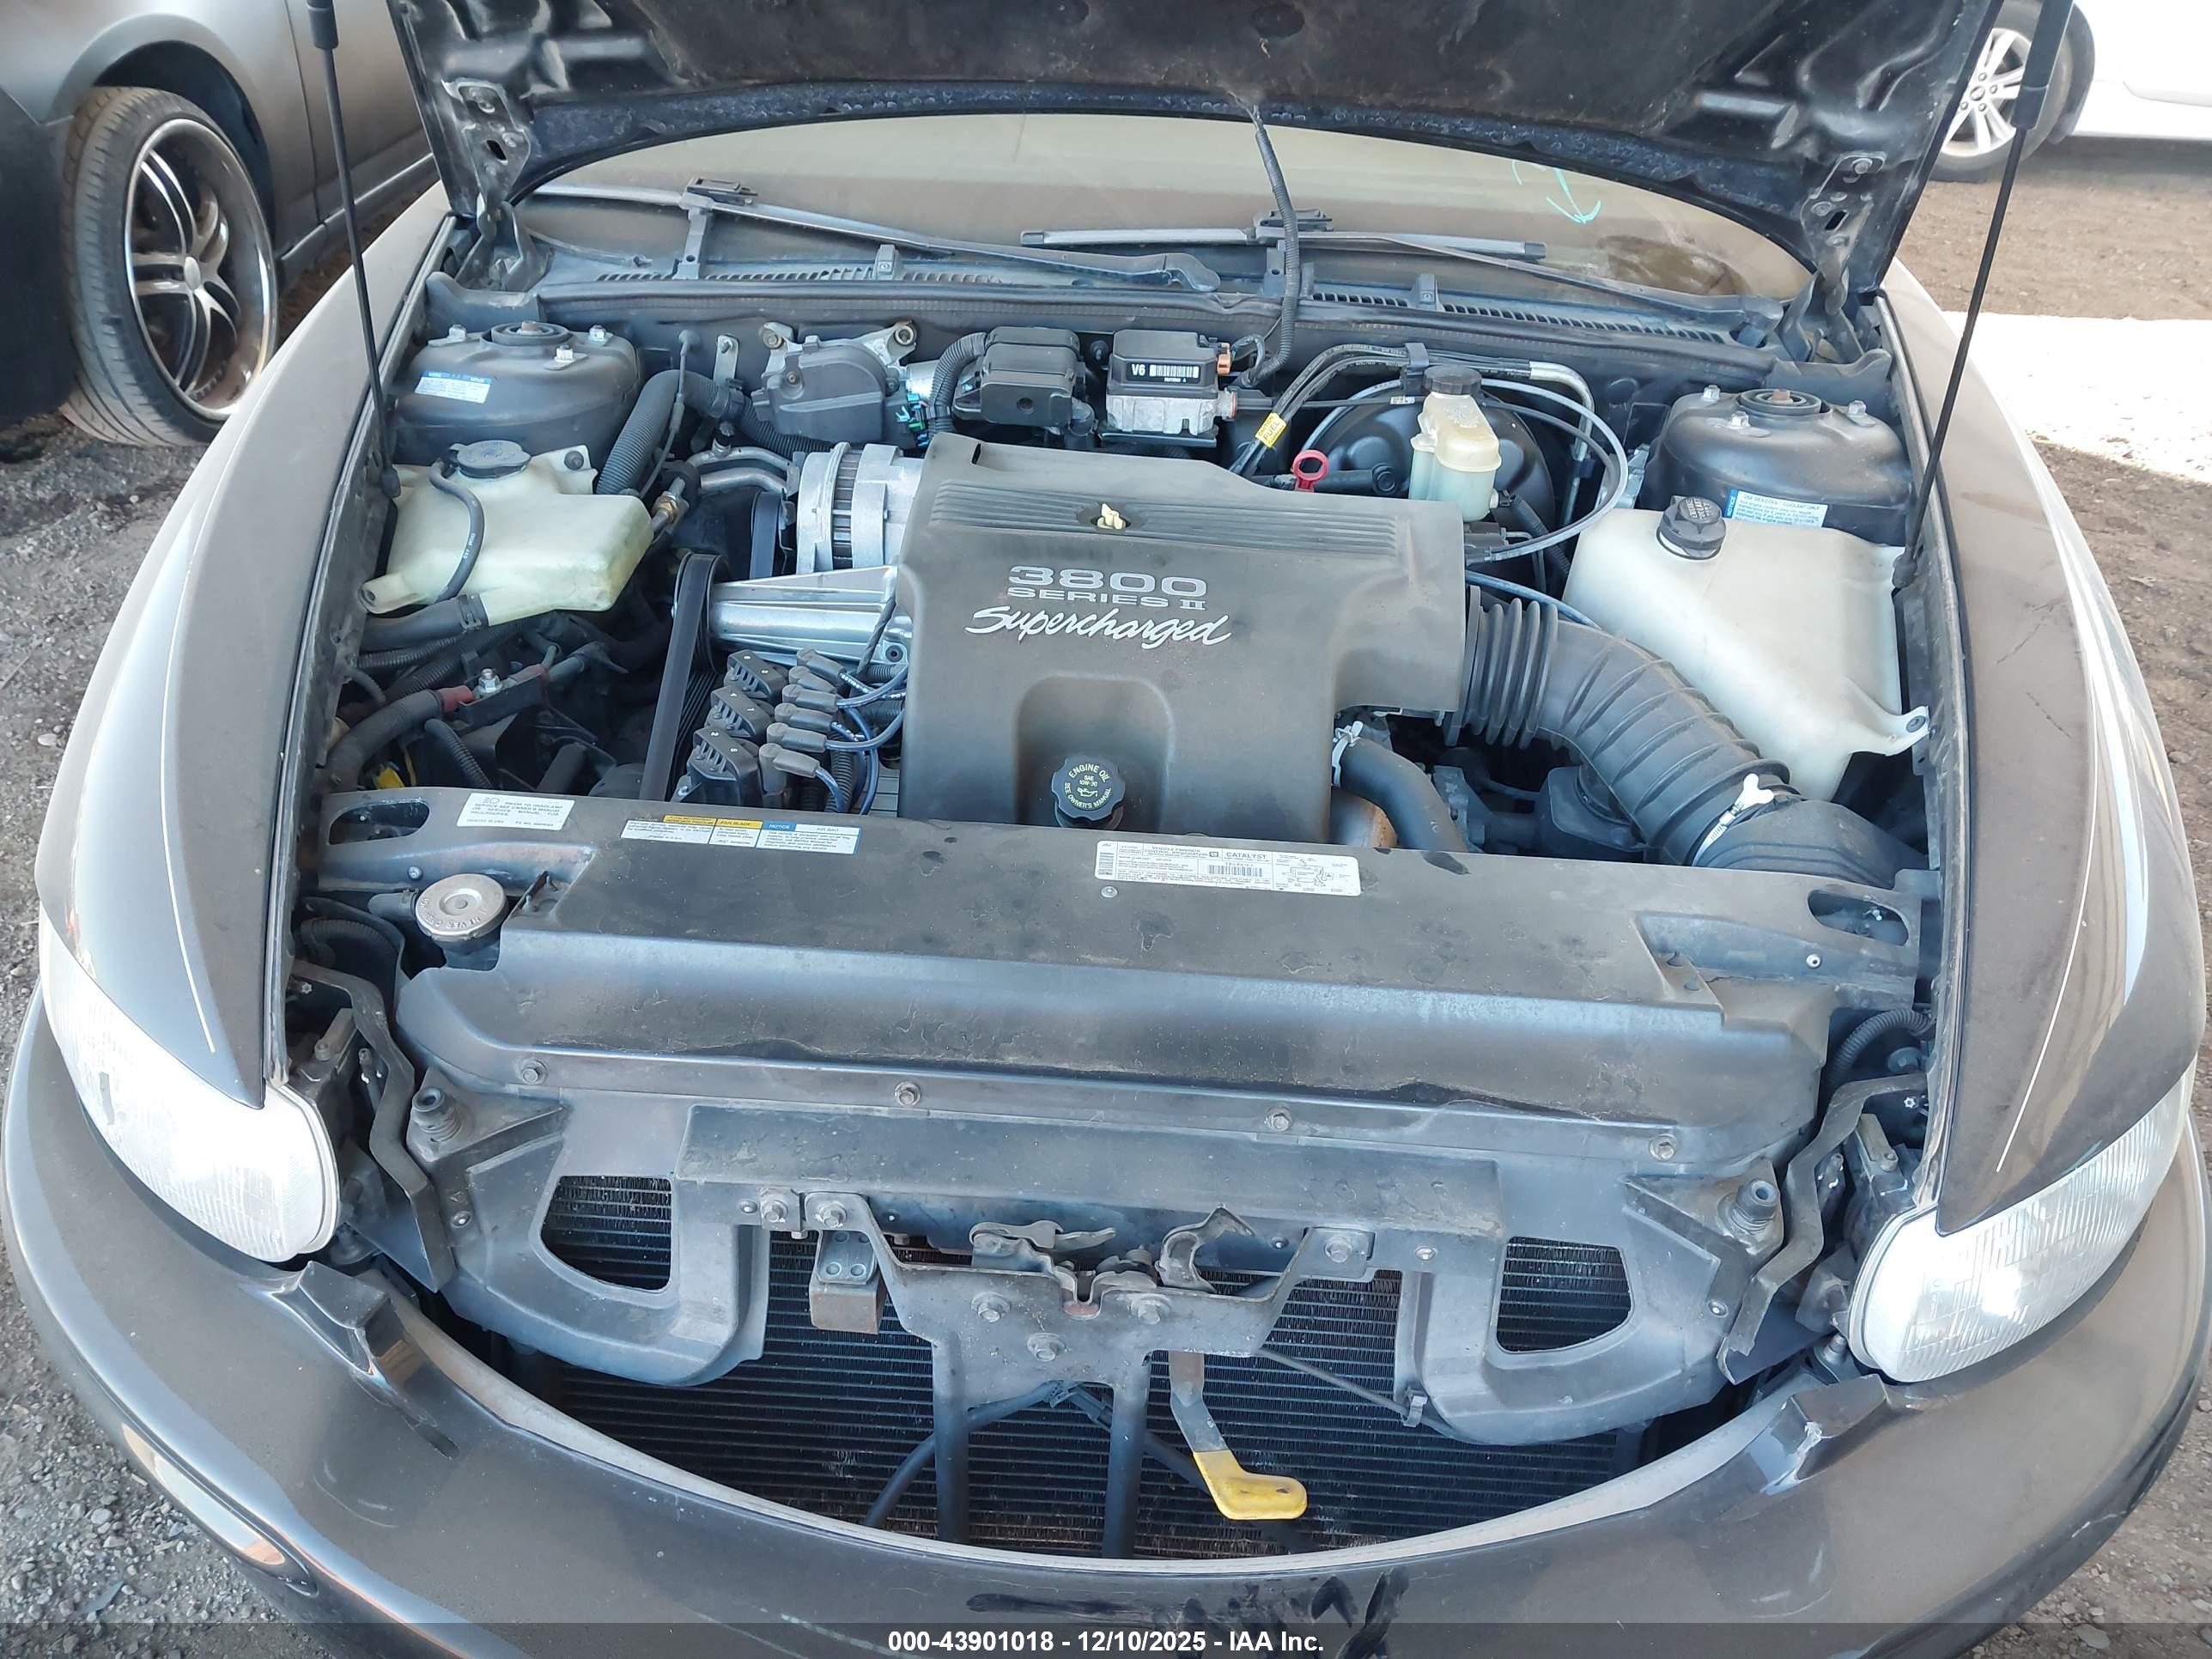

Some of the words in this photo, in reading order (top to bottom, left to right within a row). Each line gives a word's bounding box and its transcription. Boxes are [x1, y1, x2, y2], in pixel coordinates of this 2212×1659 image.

[1131, 363, 1146, 376] V6
[1263, 422, 1279, 441] FUEL
[1008, 565, 1207, 597] 3800
[1006, 586, 1169, 608] SERIES
[1180, 599, 1206, 611] II
[964, 605, 1231, 650] Supercharged
[1068, 763, 1100, 778] ENGINE
[1099, 769, 1110, 782] OIL
[1067, 794, 1092, 809] OWNER'S
[1093, 787, 1112, 807] MANUAL
[1226, 851, 1267, 860] CATALYST
